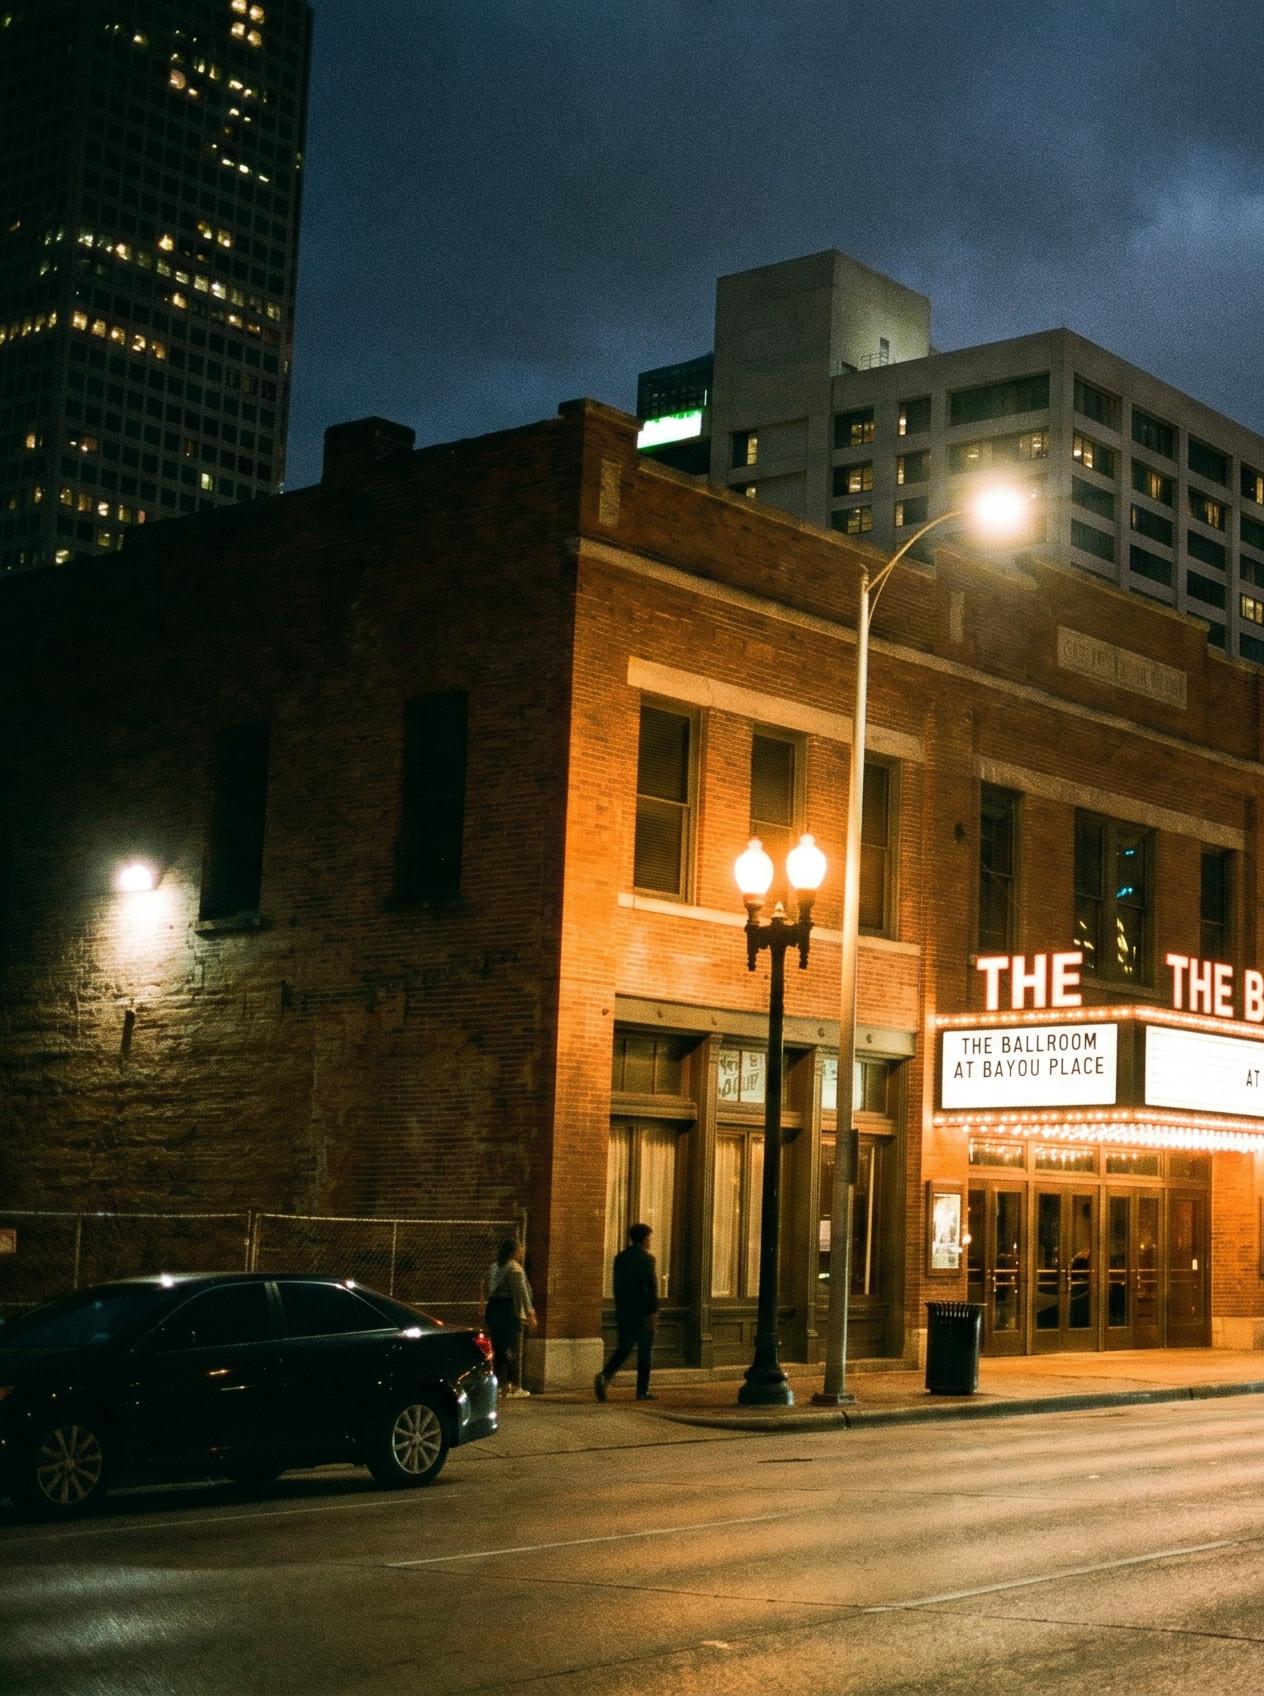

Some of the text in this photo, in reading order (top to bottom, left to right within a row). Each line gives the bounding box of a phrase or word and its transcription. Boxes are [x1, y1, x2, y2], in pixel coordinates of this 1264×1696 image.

[976, 951, 1083, 1012] THE
[1166, 953, 1234, 1018] THE
[962, 1032, 1097, 1055] THE BALLROOM
[953, 1056, 1105, 1079] AT BAYOU PLACE
[1246, 1068, 1260, 1088] AT
